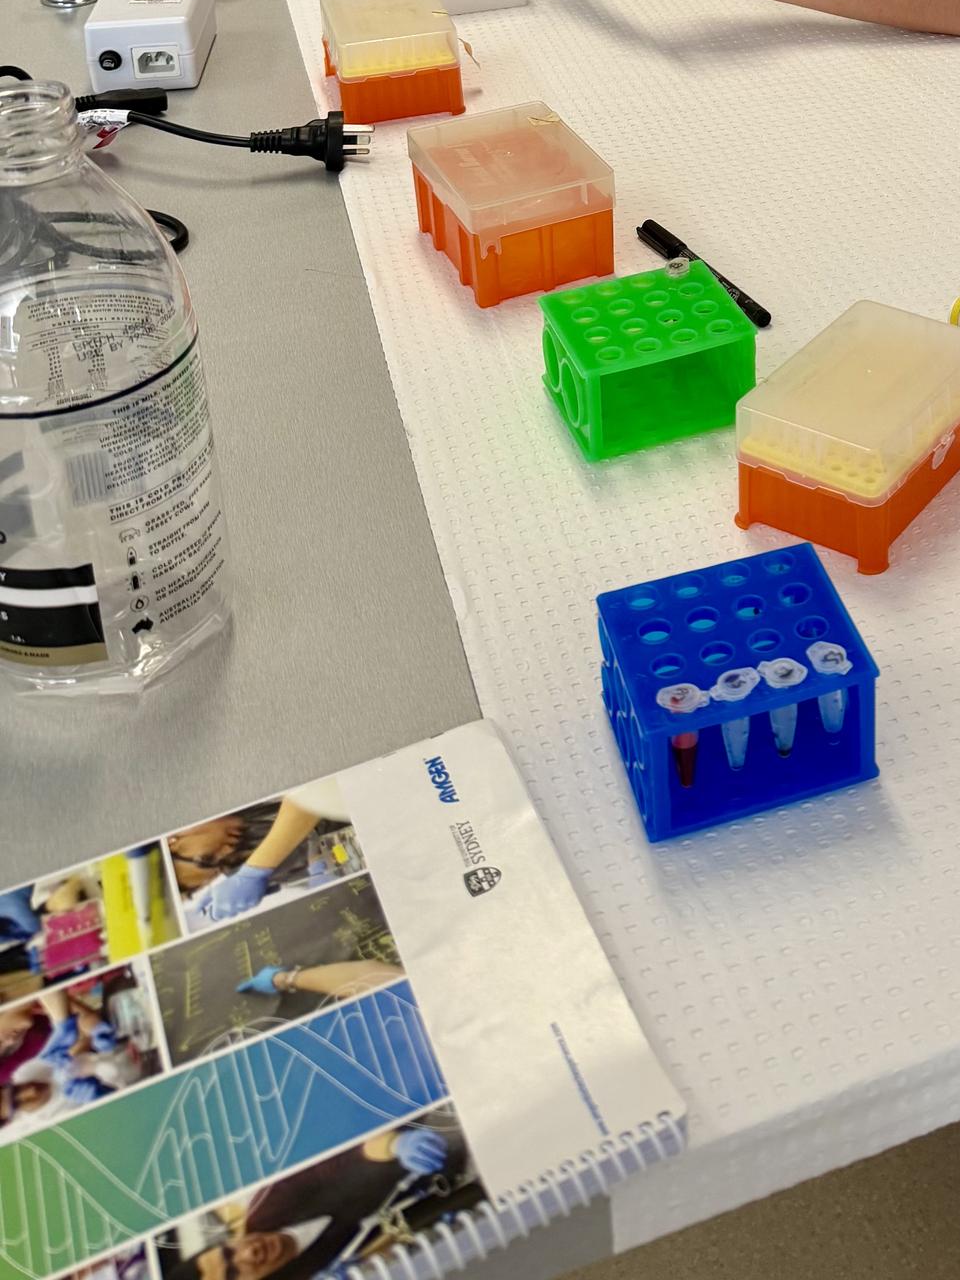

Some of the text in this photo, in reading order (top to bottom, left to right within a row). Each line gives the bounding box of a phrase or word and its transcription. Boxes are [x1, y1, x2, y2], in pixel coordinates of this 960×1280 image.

[112, 405, 130, 415] THIS
[113, 446, 132, 458] COLD
[110, 503, 131, 514] THIS
[135, 497, 144, 505] IS
[148, 483, 169, 499] COLD
[110, 506, 139, 521] DIRECT
[141, 494, 163, 509] FROM
[164, 481, 185, 499] FARM,
[146, 516, 173, 533] JERSEY
[148, 526, 182, 551] STRAIGHT
[182, 514, 200, 530] FROM
[150, 548, 160, 556] TO
[152, 559, 173, 574] COLD
[153, 556, 186, 580] HARMFUL
[155, 586, 166, 595] NO
[168, 574, 186, 589] HEAT
[157, 593, 166, 601] OR
[425, 756, 459, 803] AMGEN
[456, 820, 486, 865] SYDNEY
